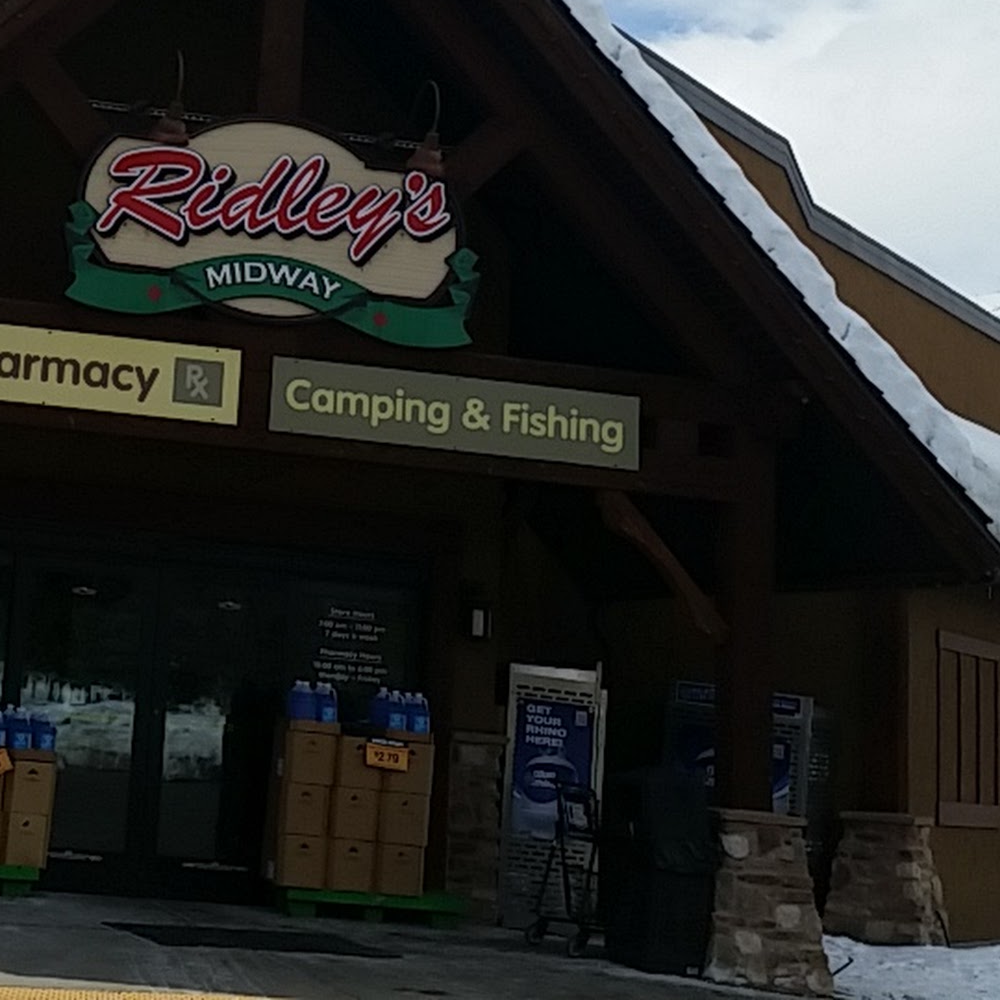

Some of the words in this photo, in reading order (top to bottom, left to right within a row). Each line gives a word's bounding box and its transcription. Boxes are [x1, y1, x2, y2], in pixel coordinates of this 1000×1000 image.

[99, 146, 450, 262] Ridley's
[206, 261, 341, 299] MIDWAY
[285, 378, 451, 434] Camping
[460, 397, 491, 432] &
[500, 402, 625, 455] Fishing
[525, 714, 562, 727] YOUR
[526, 703, 553, 715] GET
[525, 723, 567, 738] RHINO
